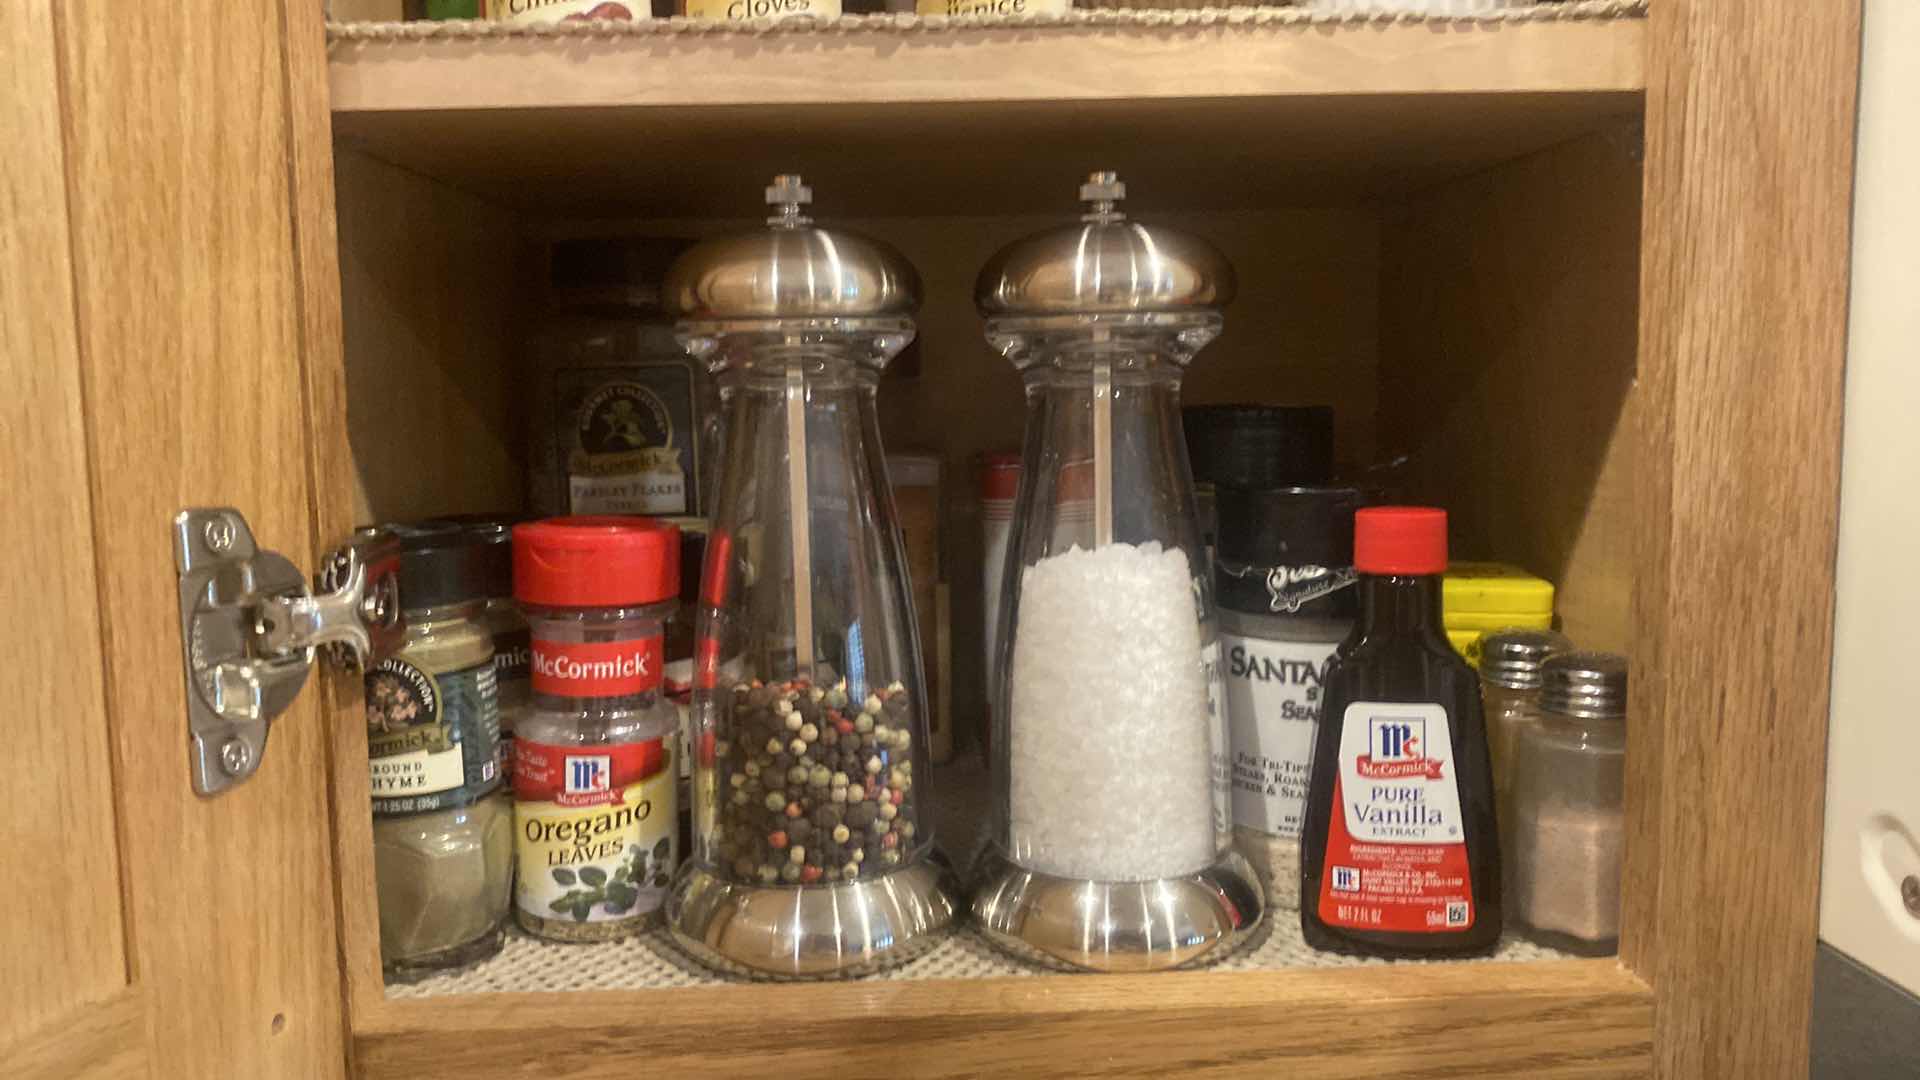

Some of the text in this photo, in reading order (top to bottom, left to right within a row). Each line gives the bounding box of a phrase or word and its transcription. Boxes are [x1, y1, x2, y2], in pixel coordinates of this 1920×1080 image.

[533, 651, 649, 680] McCormick
[1230, 645, 1322, 685] SANTA
[380, 659, 434, 709] OLLECTION
[370, 730, 430, 754] ormick
[373, 762, 423, 775] ROUND
[1361, 761, 1431, 776] McCormick
[372, 775, 426, 789] HYME
[557, 791, 617, 806] McCormick
[1372, 786, 1425, 802] PURE
[525, 800, 652, 847] Oregano
[1354, 803, 1443, 825] Vanilla
[1372, 828, 1426, 837] EXTRACT
[548, 838, 624, 866] LEAVES
